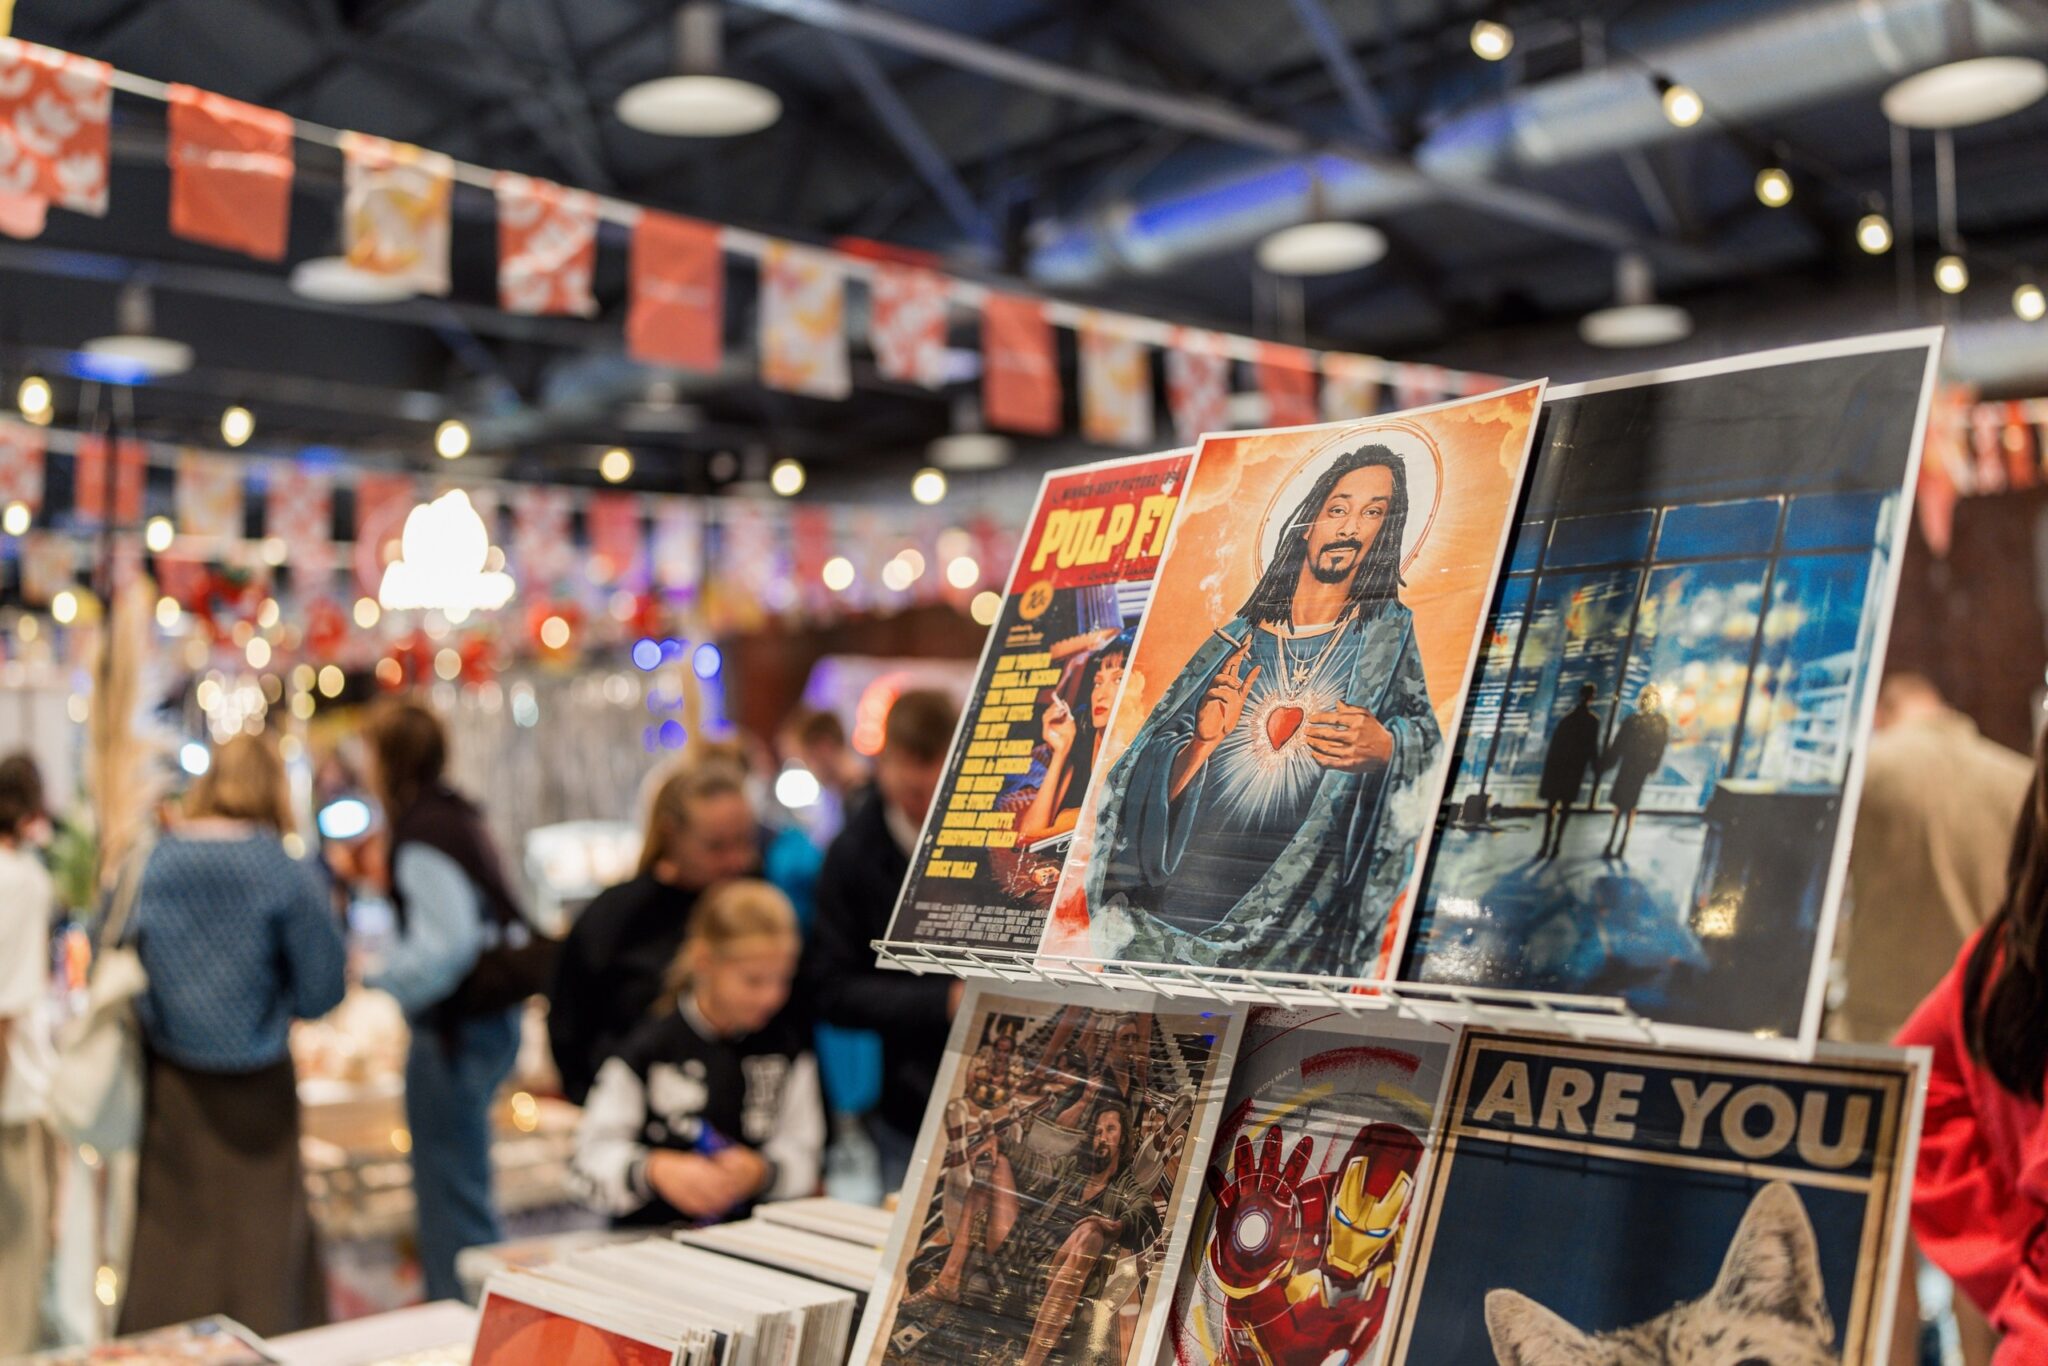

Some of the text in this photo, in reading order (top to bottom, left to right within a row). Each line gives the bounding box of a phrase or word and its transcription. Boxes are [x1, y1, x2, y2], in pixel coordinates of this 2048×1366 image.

[1030, 503, 1135, 572] PULP
[1254, 1066, 1295, 1097] IRON MAN
[1473, 1060, 1873, 1169] ARE YOU
